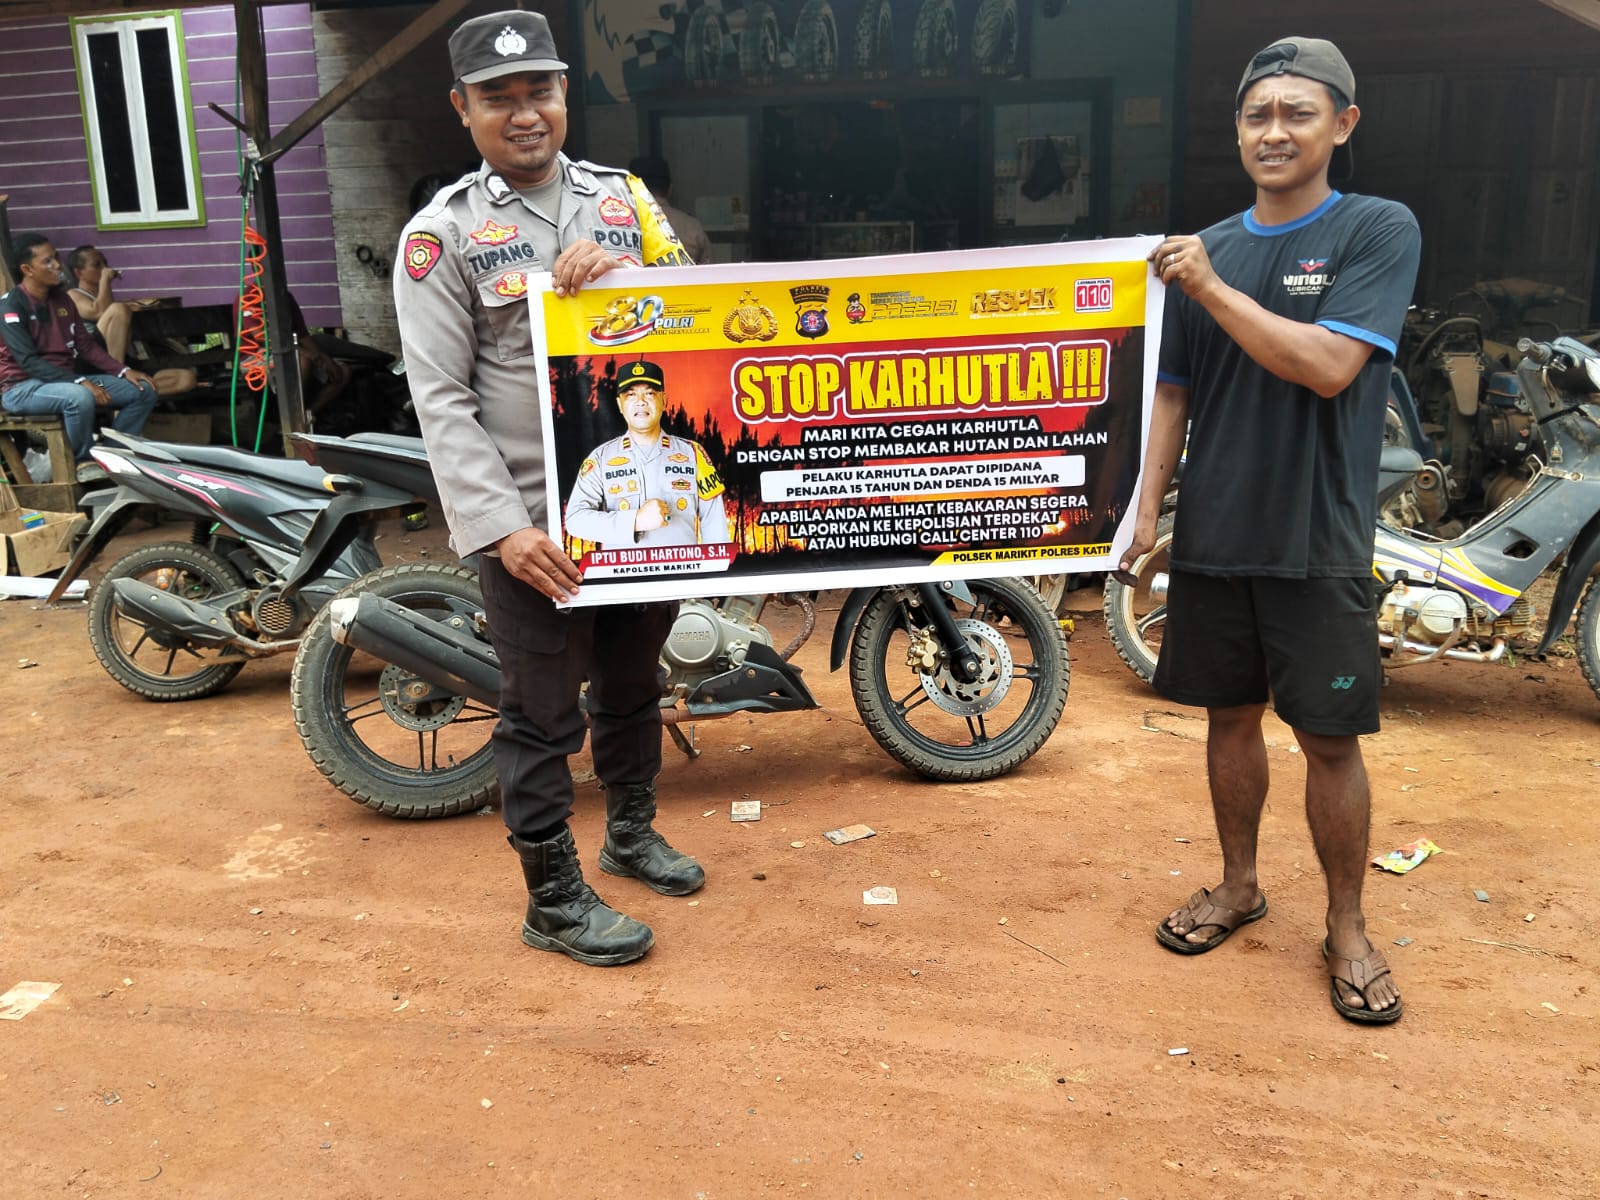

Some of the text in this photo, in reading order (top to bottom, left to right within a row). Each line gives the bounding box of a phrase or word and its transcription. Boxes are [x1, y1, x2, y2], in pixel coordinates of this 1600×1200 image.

[468, 242, 535, 274] TUPANG
[971, 288, 1057, 313] RESPEK
[1078, 286, 1109, 306] 110
[654, 317, 694, 329] POLRI
[737, 347, 1103, 418] STOP KARHUTLA !!!
[804, 419, 1039, 442] MARI KITA CEGAH KARHUTLA
[736, 432, 1108, 463] DENGAN STOP MEMBAKAR HUTAN DAN LAHAN
[665, 465, 695, 475] POLRI
[802, 461, 1042, 483] PELAKU KARHUTLA DAPAT DIPIDANA
[786, 474, 1060, 497] PENJARA 15 TAHUN DAN DENDA 15 MILYAR
[759, 495, 1088, 524] APABILA ANDA MELIHAT KEBAKARAN SEGERA
[790, 511, 1060, 537] LAPORKAN KE KEPOLISIAN TERDEKAT
[808, 526, 1041, 550] ATAU HUBUNGI CALL CENTER 110
[591, 545, 730, 565] IPTU BUDI HARTONO, S.H.
[953, 551, 992, 563] POLSEK
[995, 549, 1037, 560] MARIKIT
[1040, 547, 1080, 558] POLRES
[613, 563, 702, 574] KAPOLSEK MARIKIT
[673, 630, 711, 641] YAMAHA
